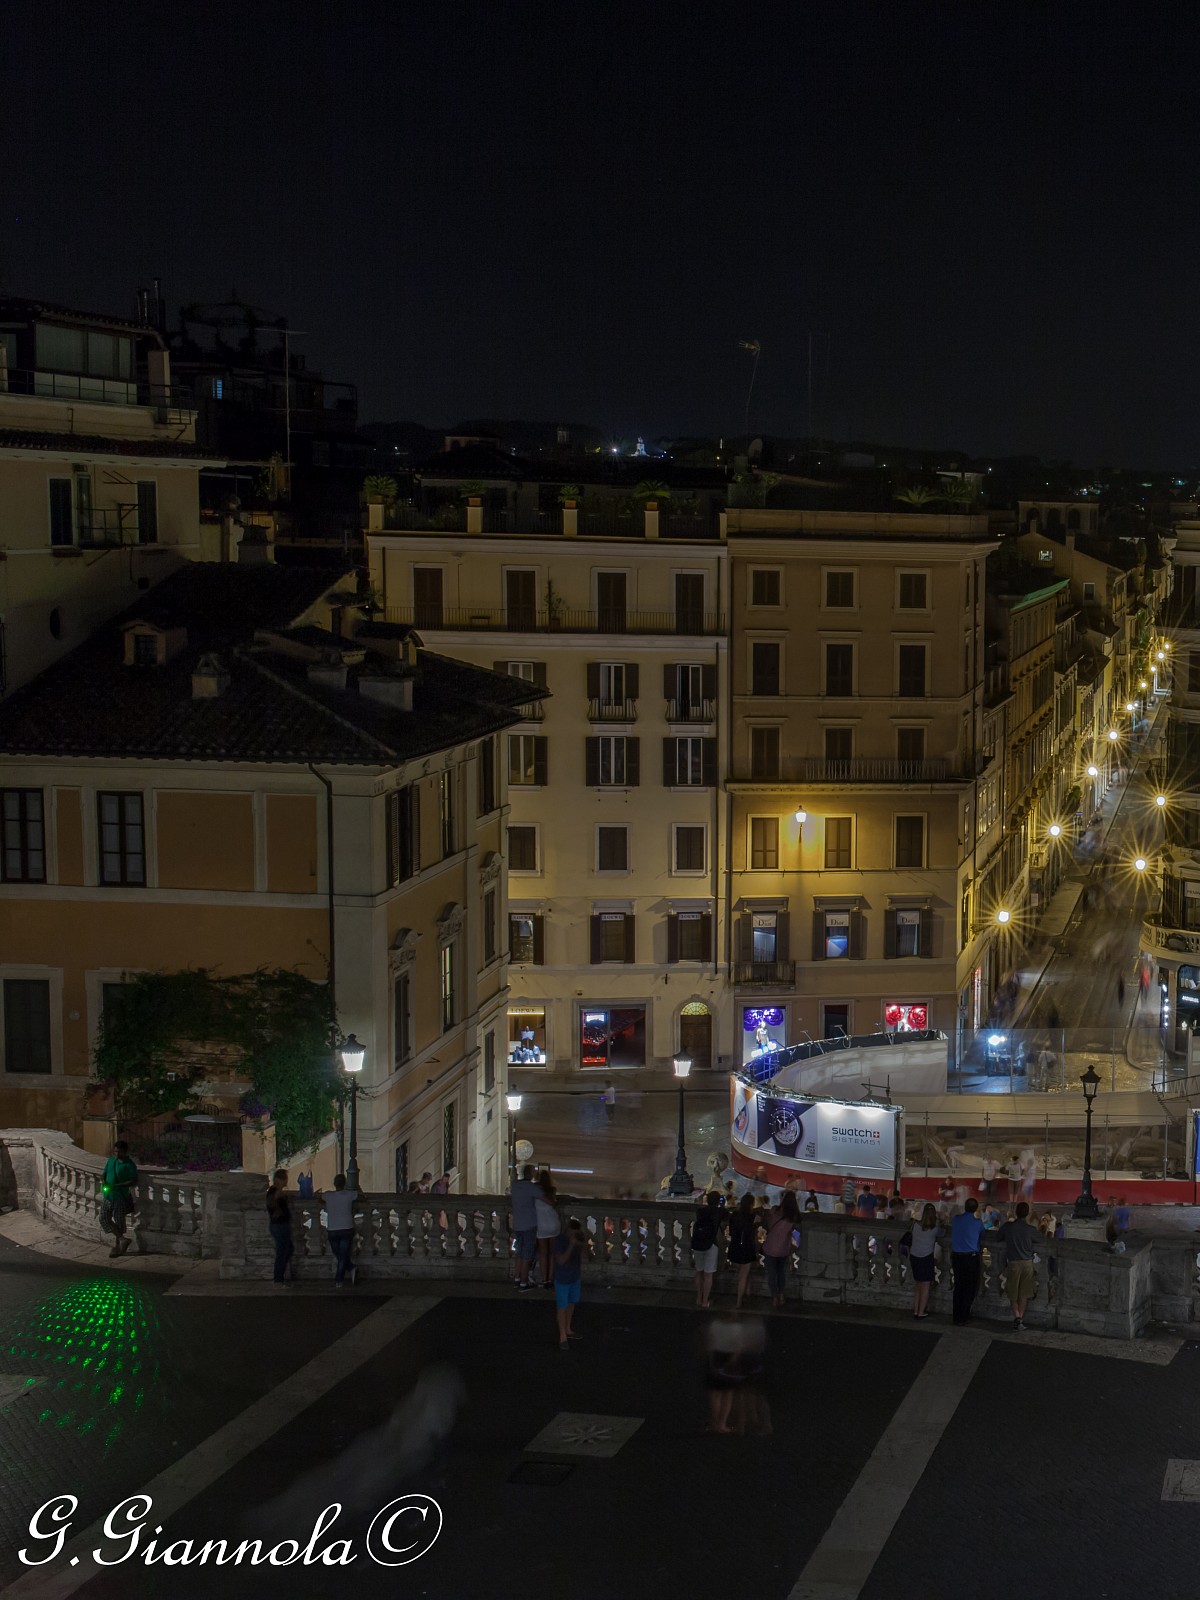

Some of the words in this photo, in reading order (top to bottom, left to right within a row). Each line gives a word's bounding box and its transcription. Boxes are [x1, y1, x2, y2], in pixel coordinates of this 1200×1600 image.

[830, 918, 845, 926] Dior
[832, 1127, 872, 1138] swatch
[832, 1136, 881, 1146] SISTEM51
